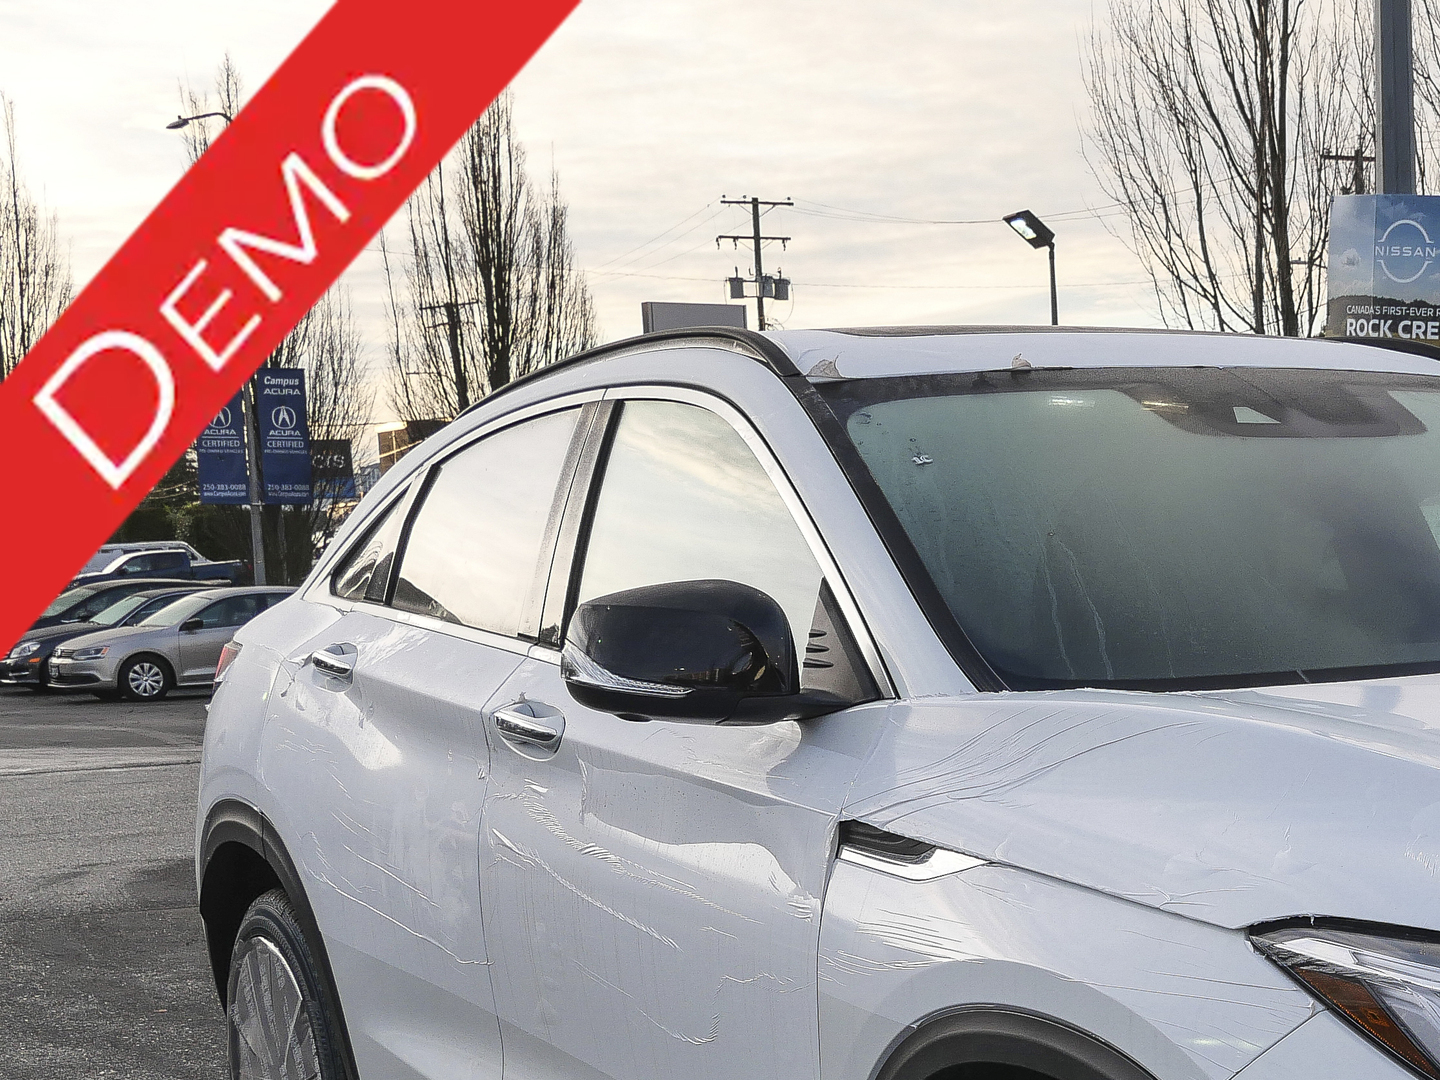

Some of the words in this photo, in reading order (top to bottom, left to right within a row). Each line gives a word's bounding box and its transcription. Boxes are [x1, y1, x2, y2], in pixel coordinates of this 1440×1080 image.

[1375, 246, 1436, 257] NISSAN
[1346, 305, 1381, 315] CANADA'S
[1382, 306, 1434, 317] FIRST-EVER
[1346, 318, 1393, 338] ROCK
[264, 376, 299, 386] Campus
[202, 440, 240, 448] CERTIFIED
[267, 440, 304, 448] CERTIFIED
